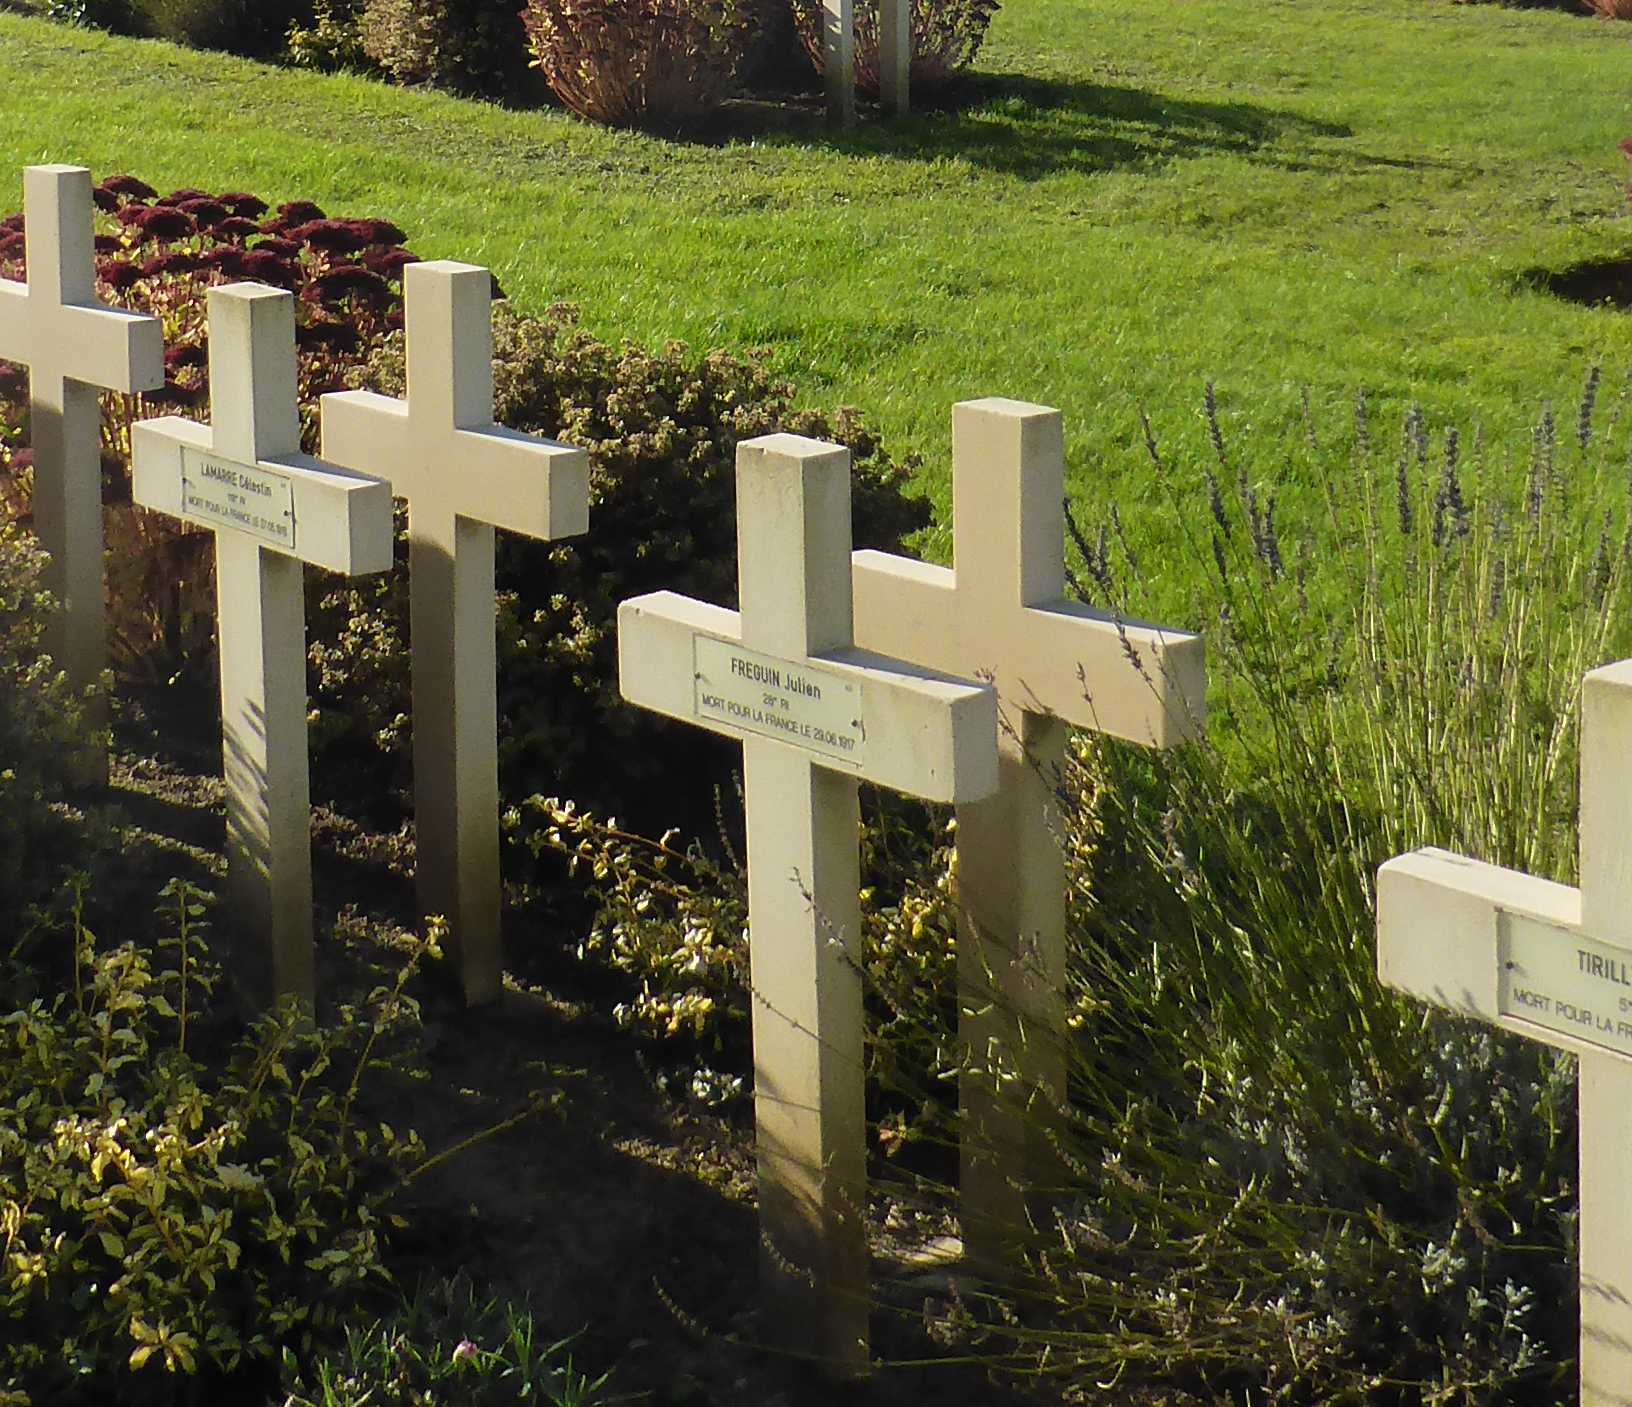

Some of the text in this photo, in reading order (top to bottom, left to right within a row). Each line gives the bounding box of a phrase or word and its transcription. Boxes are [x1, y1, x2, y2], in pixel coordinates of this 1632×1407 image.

[731, 657, 821, 700] FREGUIN Julien
[702, 693, 725, 711] MORT
[728, 701, 751, 718] POUR
[752, 709, 763, 724] LA
[765, 713, 799, 734] FRANCE
[801, 724, 811, 738] LE
[1513, 987, 1551, 1009] MORT
[1555, 1000, 1592, 1026] POUR
[1596, 1012, 1613, 1033] LA
